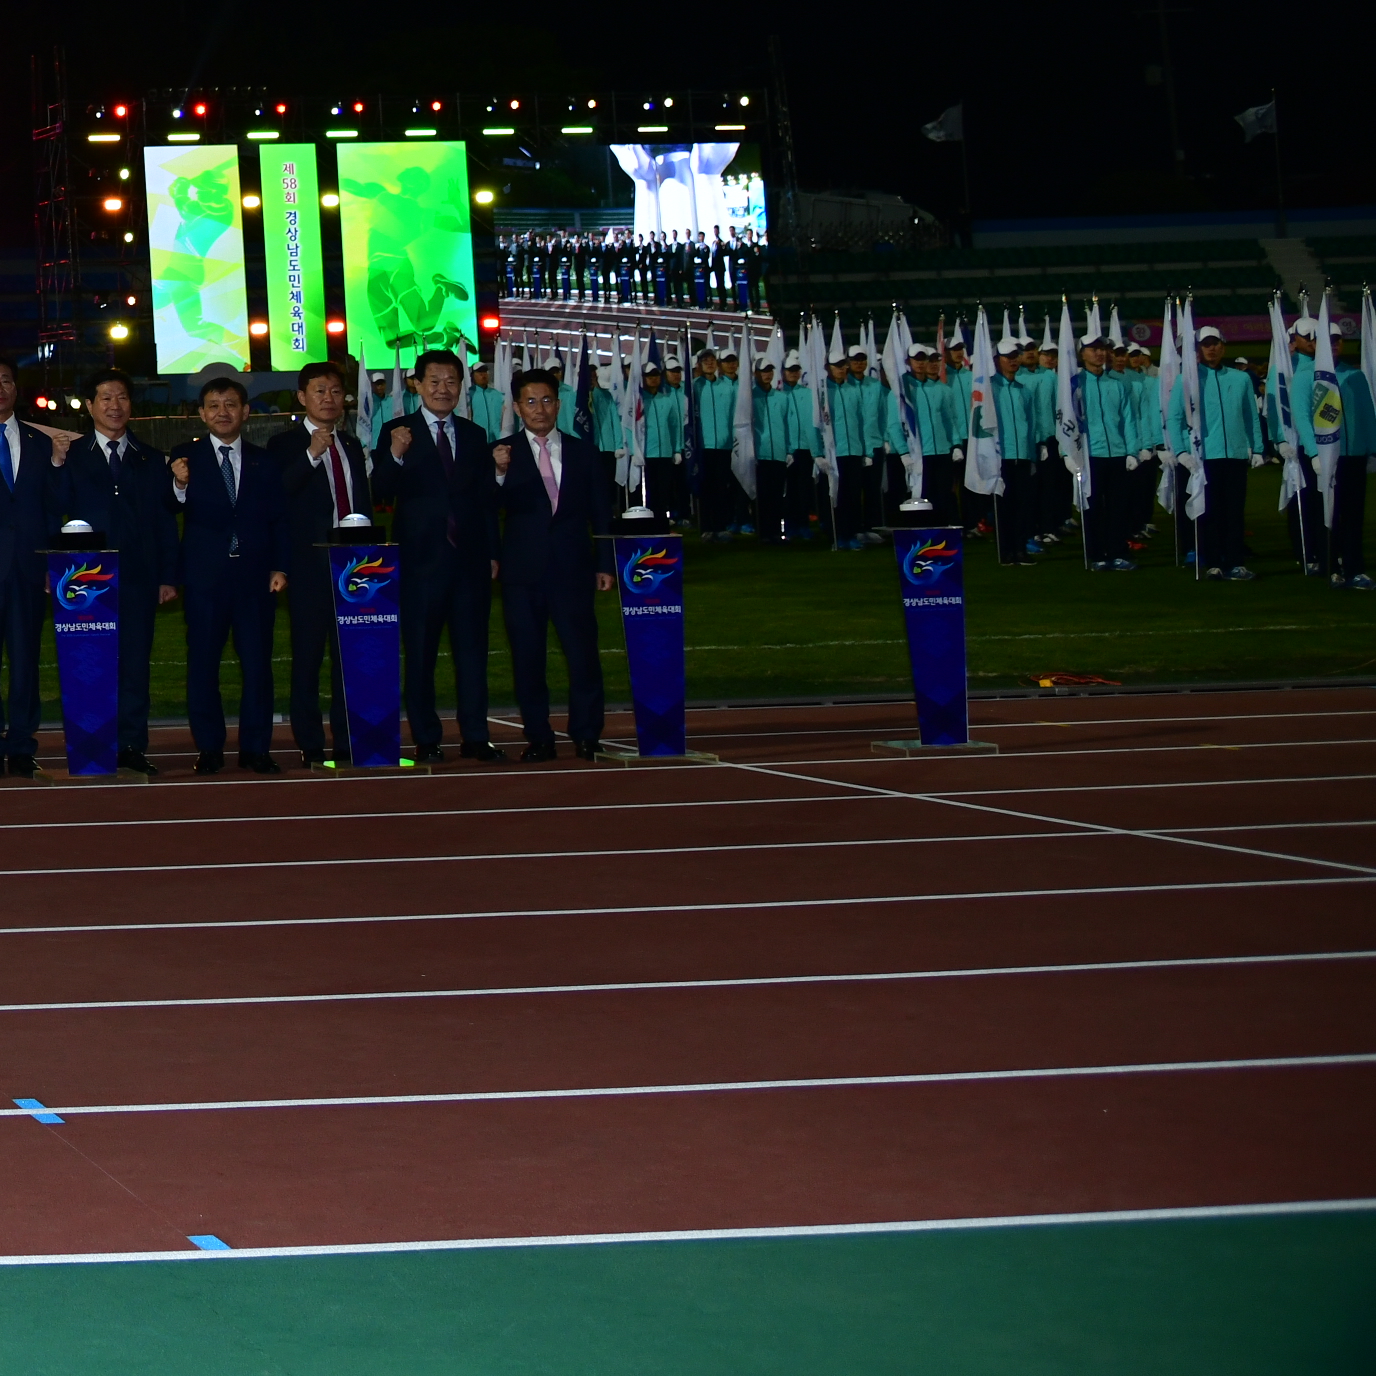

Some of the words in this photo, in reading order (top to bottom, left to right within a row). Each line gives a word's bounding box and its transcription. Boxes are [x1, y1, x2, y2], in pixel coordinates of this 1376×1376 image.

[282, 162, 297, 204] 제58회
[285, 210, 306, 352] 경상남도민체육대회
[622, 605, 681, 615] 경상남도민체육대회
[337, 614, 398, 625] 경상남도민체육대회
[55, 622, 116, 632] 경상남도민체육대회
